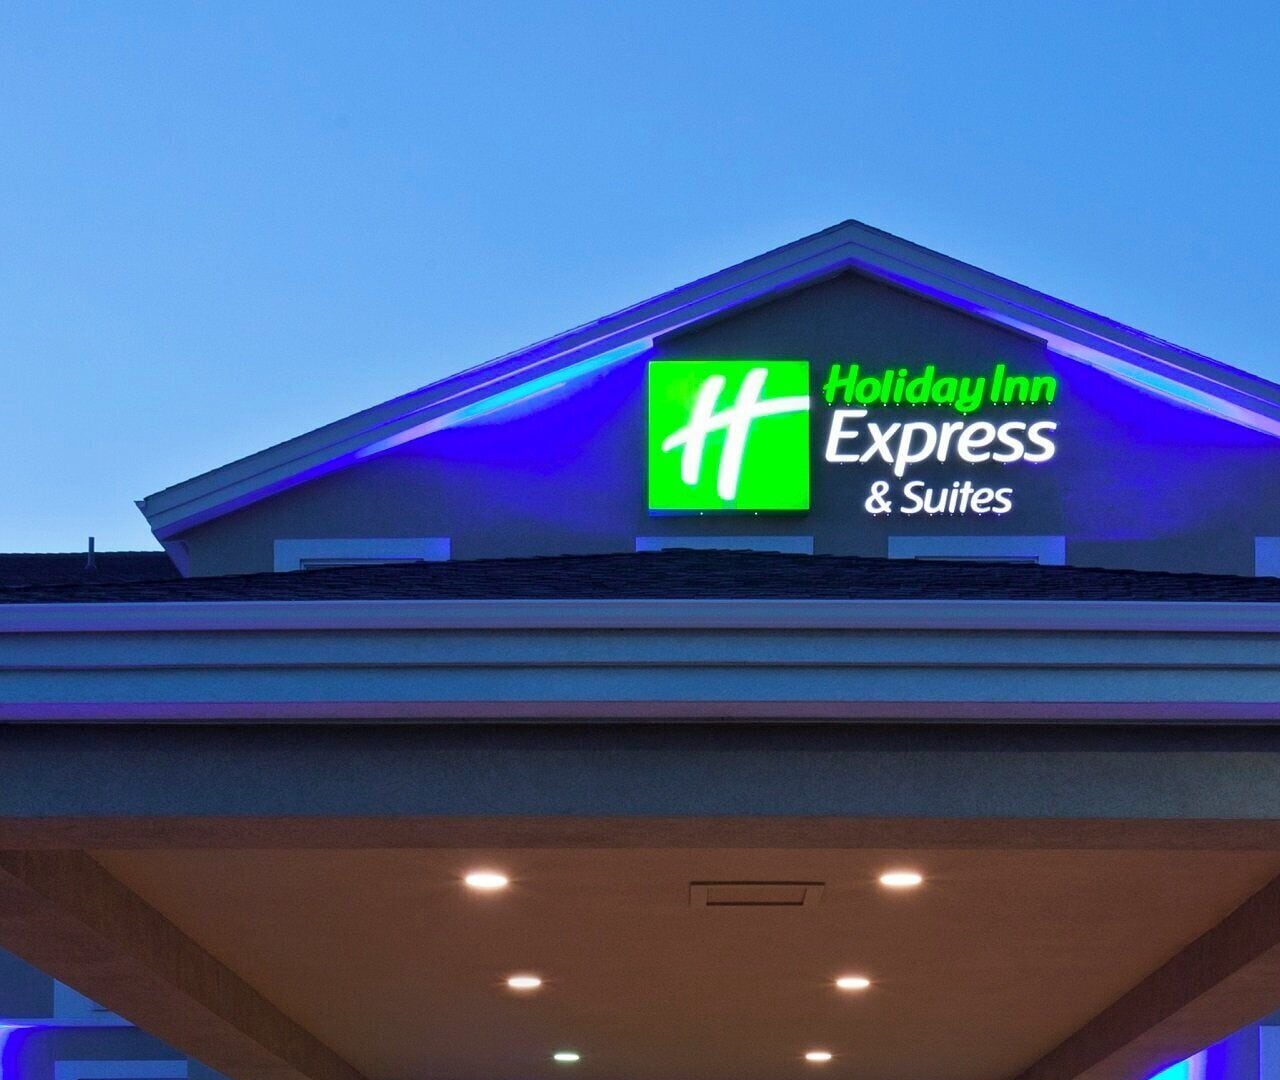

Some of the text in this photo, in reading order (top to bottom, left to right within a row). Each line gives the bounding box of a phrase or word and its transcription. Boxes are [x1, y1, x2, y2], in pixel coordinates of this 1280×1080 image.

[822, 364, 1057, 412] Holiday Inn
[825, 409, 1058, 477] Express
[864, 480, 1013, 514] & Suites
